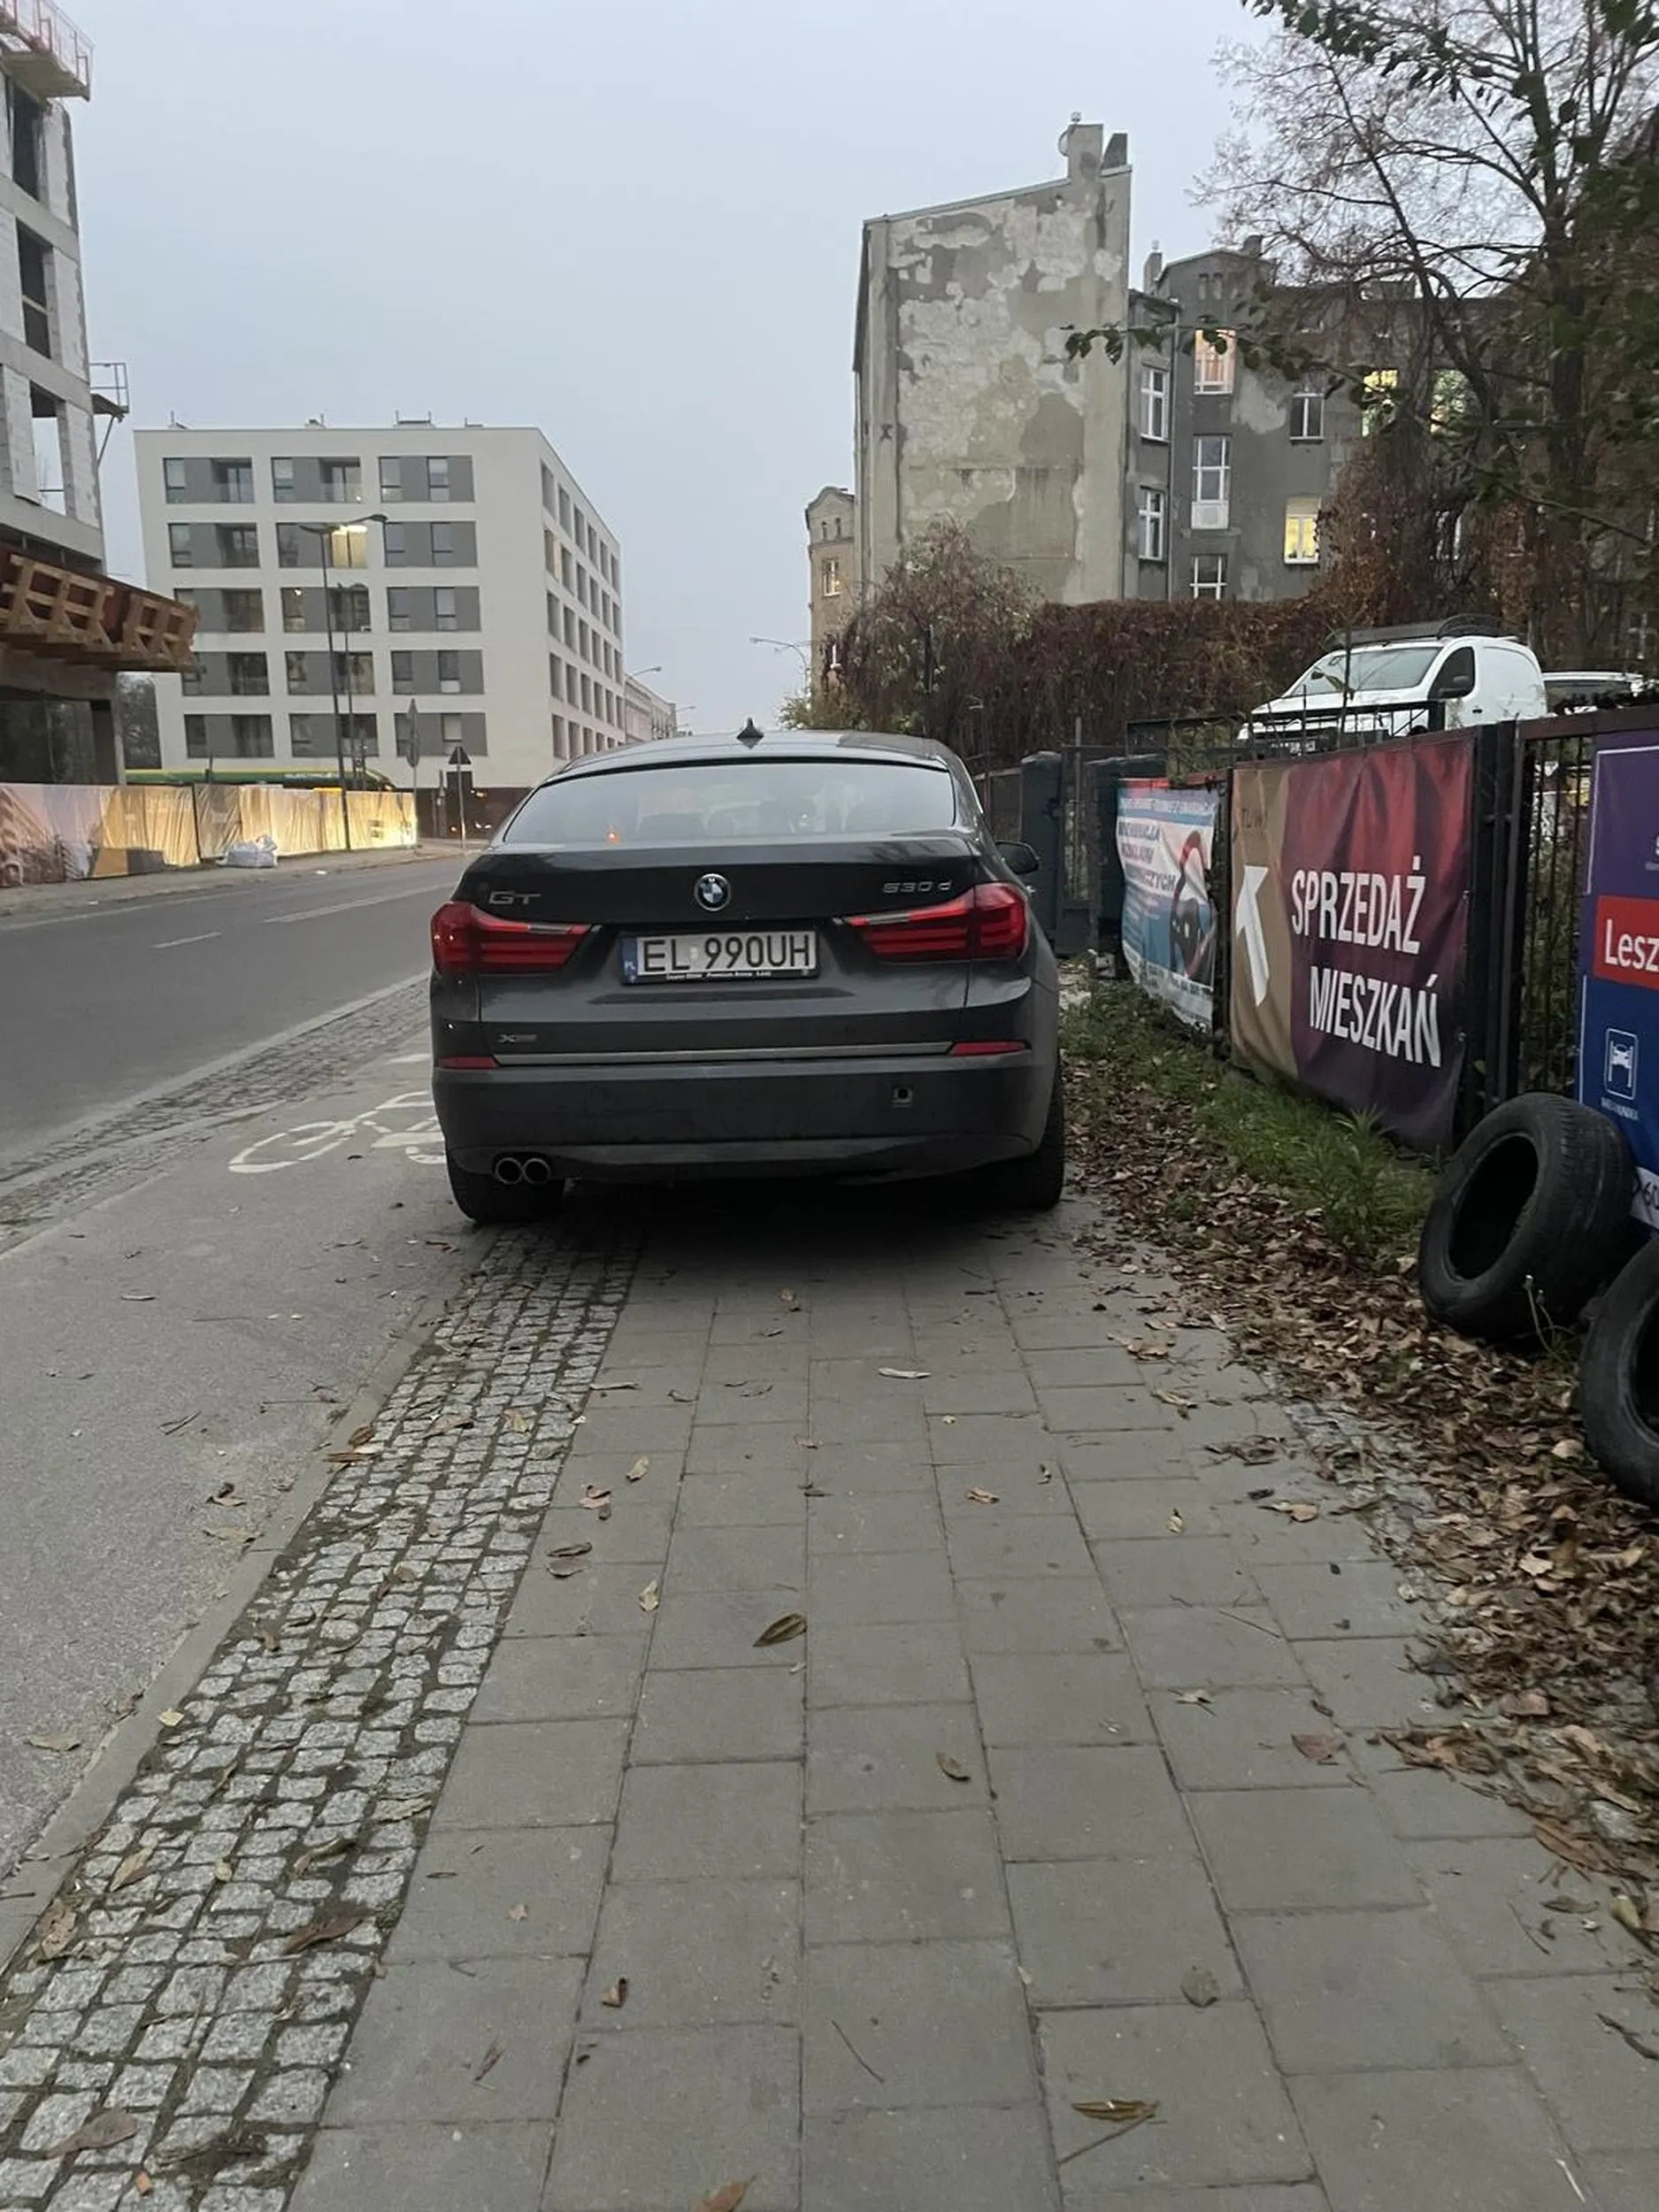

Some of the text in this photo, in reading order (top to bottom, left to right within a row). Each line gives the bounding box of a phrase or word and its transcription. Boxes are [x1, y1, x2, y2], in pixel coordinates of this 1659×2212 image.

[489, 891, 541, 905] GT
[1291, 855, 1425, 955] SPRZEDAŻ
[643, 939, 690, 972] EL
[704, 933, 810, 970] 990UH
[1310, 965, 1441, 1068] MIESZKAŃ
